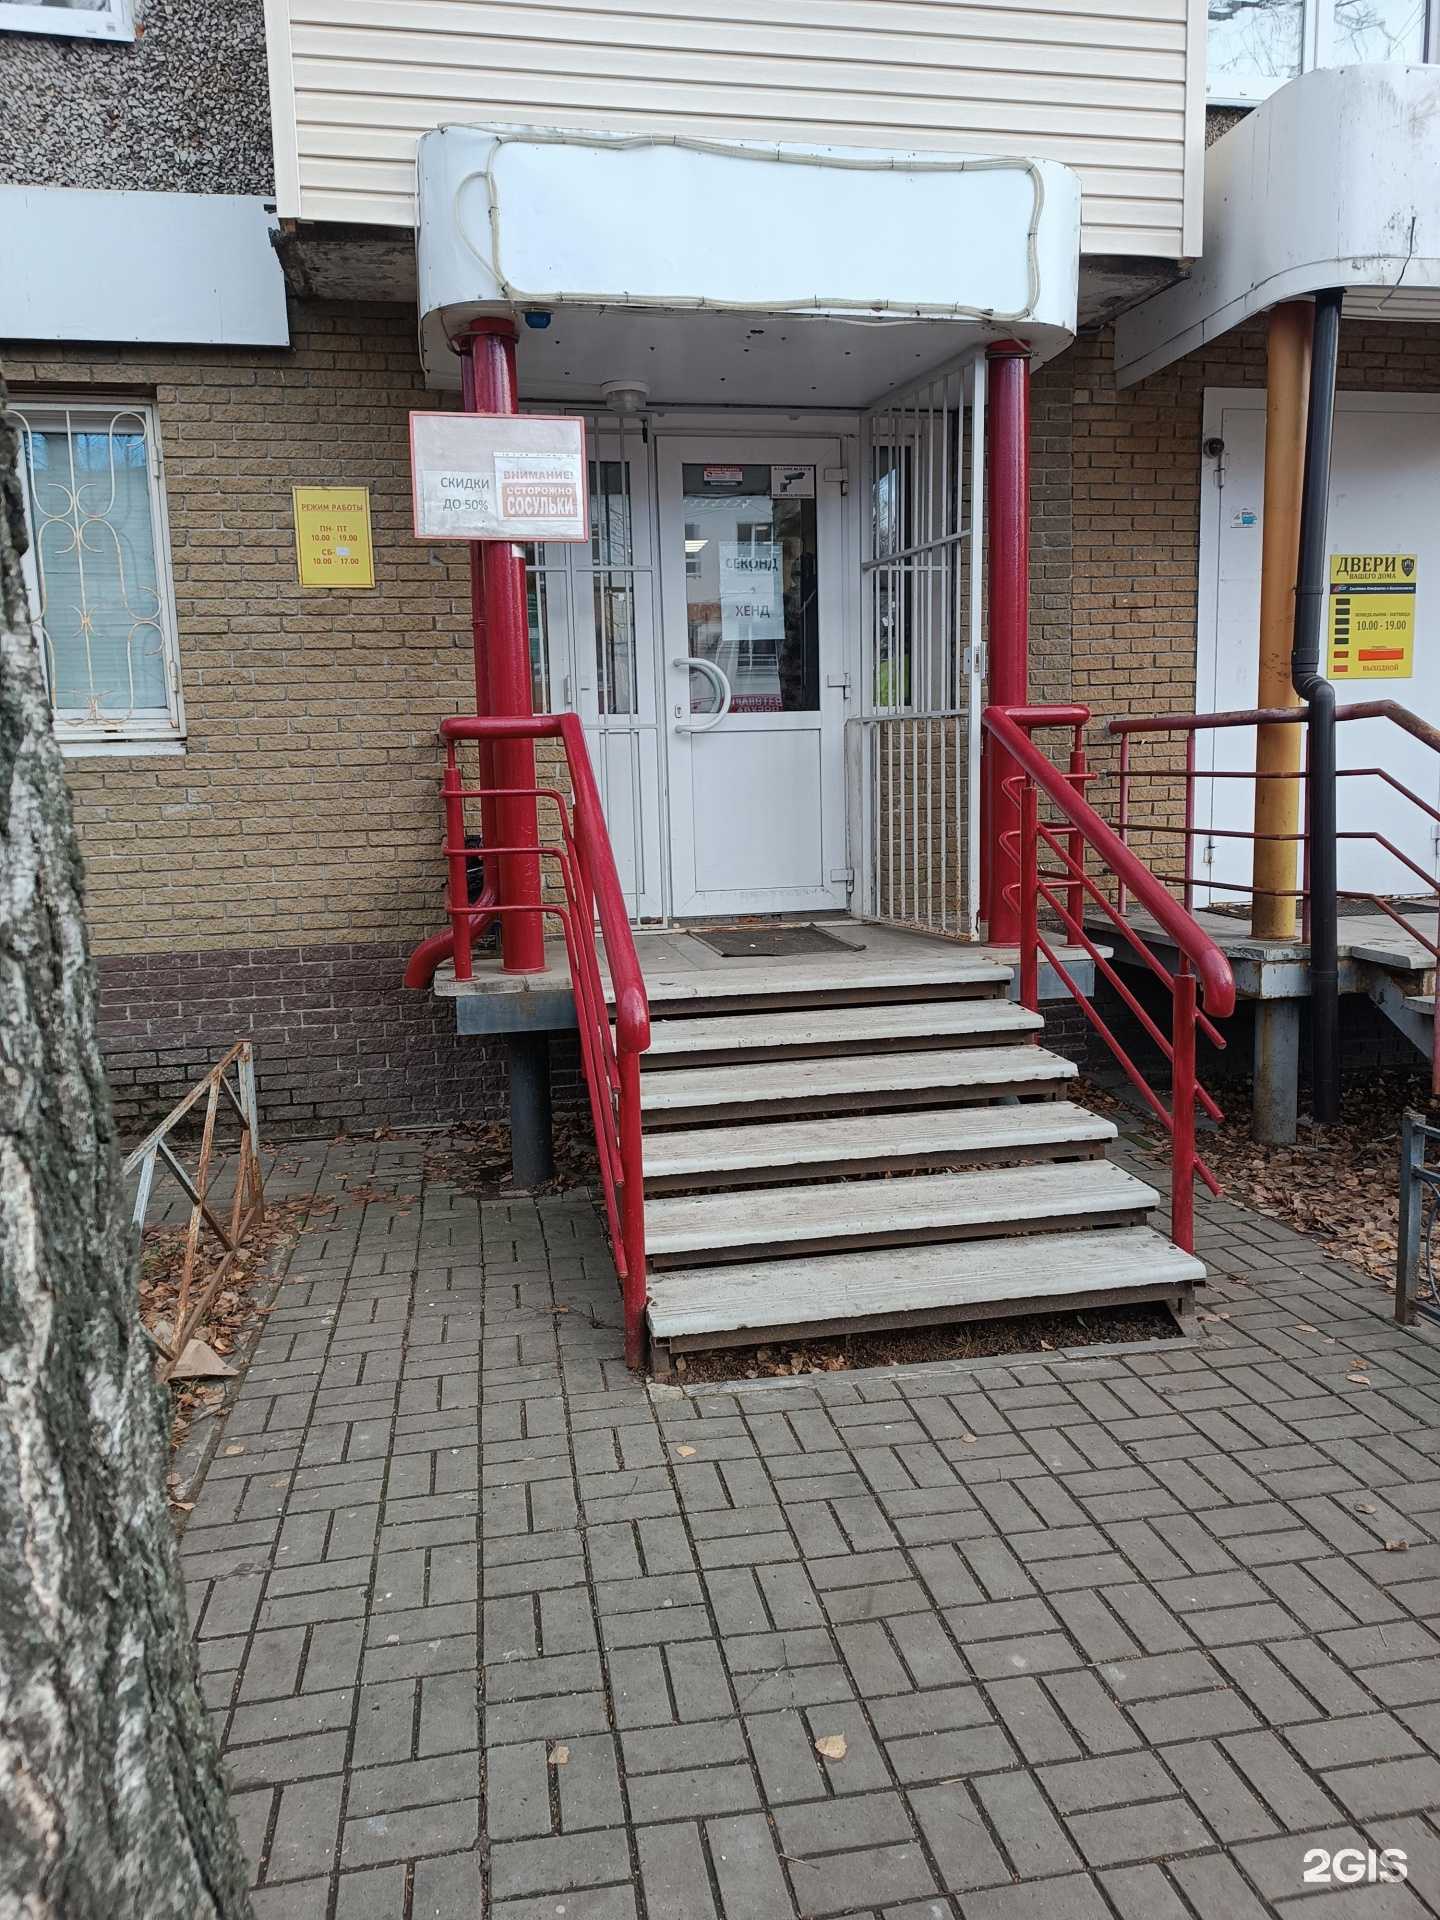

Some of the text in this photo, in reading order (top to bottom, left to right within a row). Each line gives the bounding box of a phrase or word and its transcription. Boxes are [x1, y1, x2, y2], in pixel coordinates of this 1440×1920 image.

[503, 469, 574, 481] ВНИМАНИЕ!
[440, 477, 490, 490] СКИДКИ
[506, 486, 573, 495] ОСТОРОЖНО
[301, 503, 363, 511] РЕЖИМ РАБОТЫ
[442, 498, 489, 512] ДО 50%
[506, 495, 574, 515] СОСУЛЬКИ
[311, 534, 330, 542] 10.00
[339, 534, 358, 542] 19.00
[313, 557, 332, 565] 10.00
[726, 558, 779, 572] СЕКОНД
[1336, 557, 1396, 576] ДВЕРИ
[735, 605, 770, 618] ХЕНД
[1357, 620, 1379, 631] 10.00
[1385, 620, 1407, 630] 19.00
